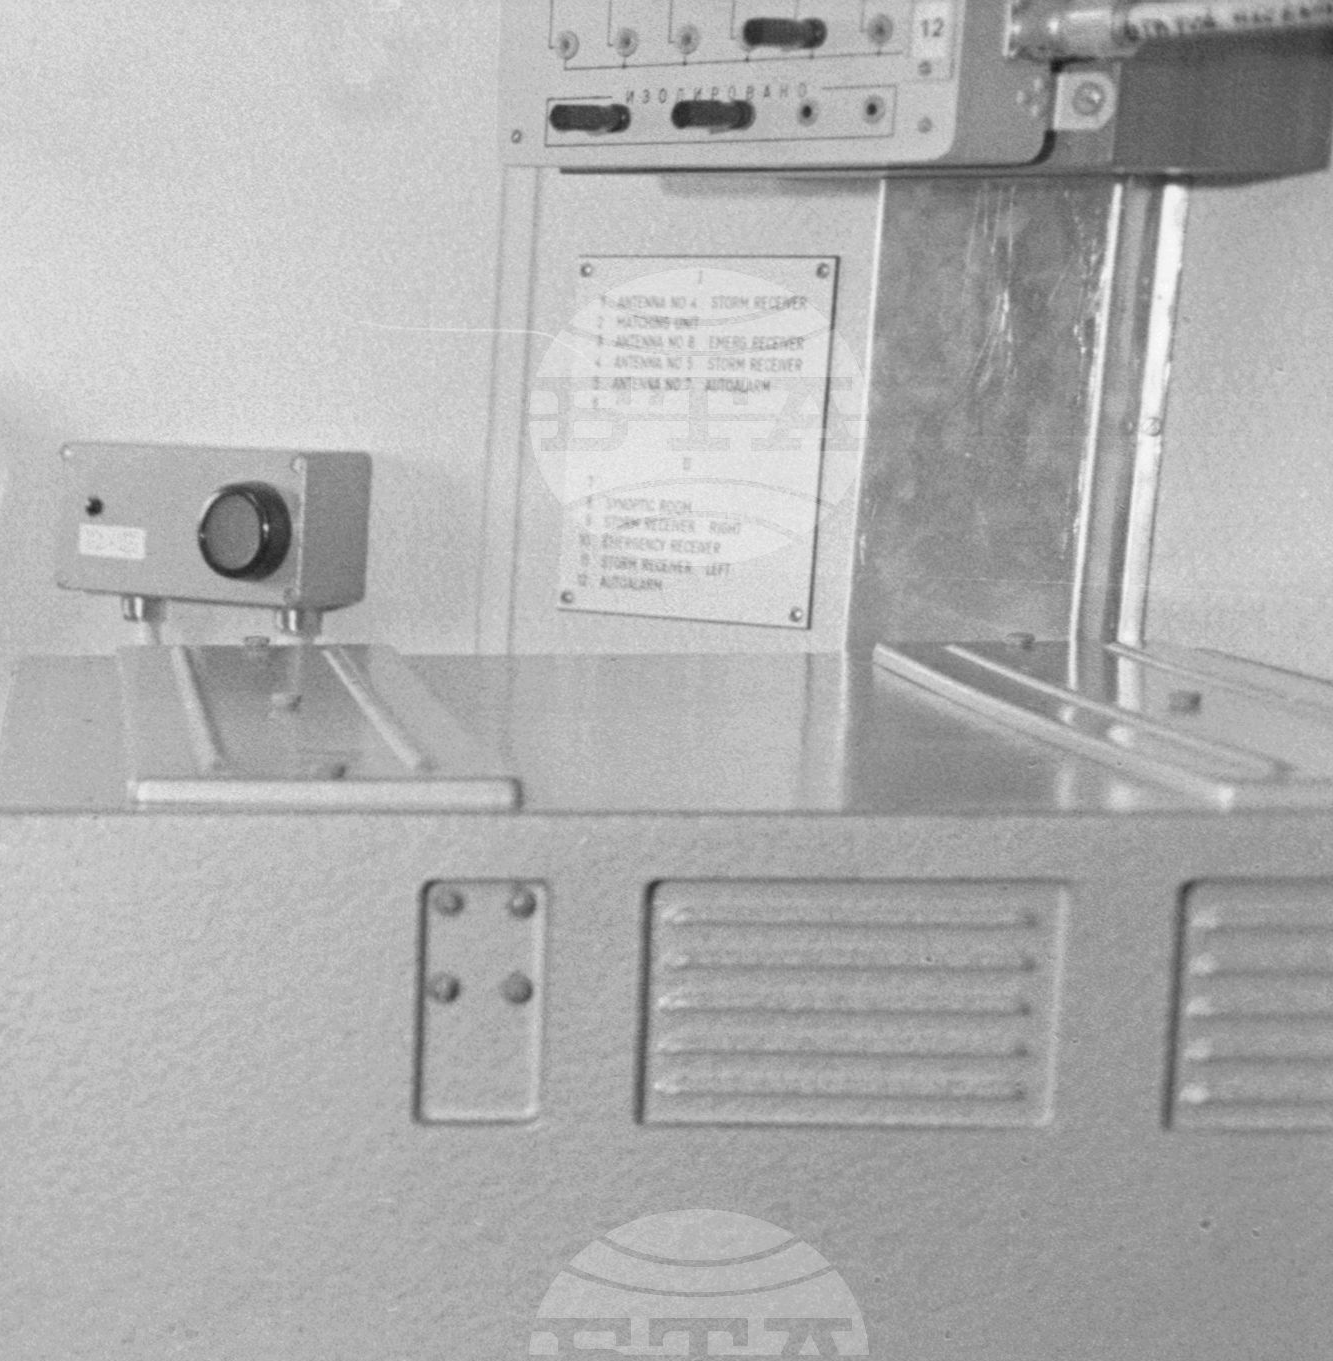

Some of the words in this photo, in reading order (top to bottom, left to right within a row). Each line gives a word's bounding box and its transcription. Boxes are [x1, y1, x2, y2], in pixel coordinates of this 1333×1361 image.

[920, 18, 945, 38] 12
[625, 81, 810, 105] ИЗОЛИРОВАНО
[616, 295, 666, 309] ANTENNA
[710, 296, 749, 310] STORM
[753, 296, 808, 311] RECEIVER
[616, 315, 670, 328] MATCHING
[673, 317, 700, 329] UNIT
[614, 334, 663, 348] ANTENNA
[751, 336, 805, 351] RECEIVER
[613, 355, 663, 369] ANTENNA
[707, 357, 745, 371] STORM
[749, 357, 804, 373] RECEIVER
[611, 377, 662, 391] ANTENNA
[704, 378, 772, 393] AUTOALARM
[659, 498, 693, 514] ROOM
[644, 516, 696, 533] RECEIVER
[709, 520, 742, 535] RIGHT
[601, 533, 666, 551] EMERGENCY
[670, 538, 722, 554] RECEIVER
[600, 554, 637, 570] STORM
[641, 557, 693, 574] RECEIVER
[705, 562, 731, 576] LEFT
[599, 574, 663, 591] AUTOALARM
